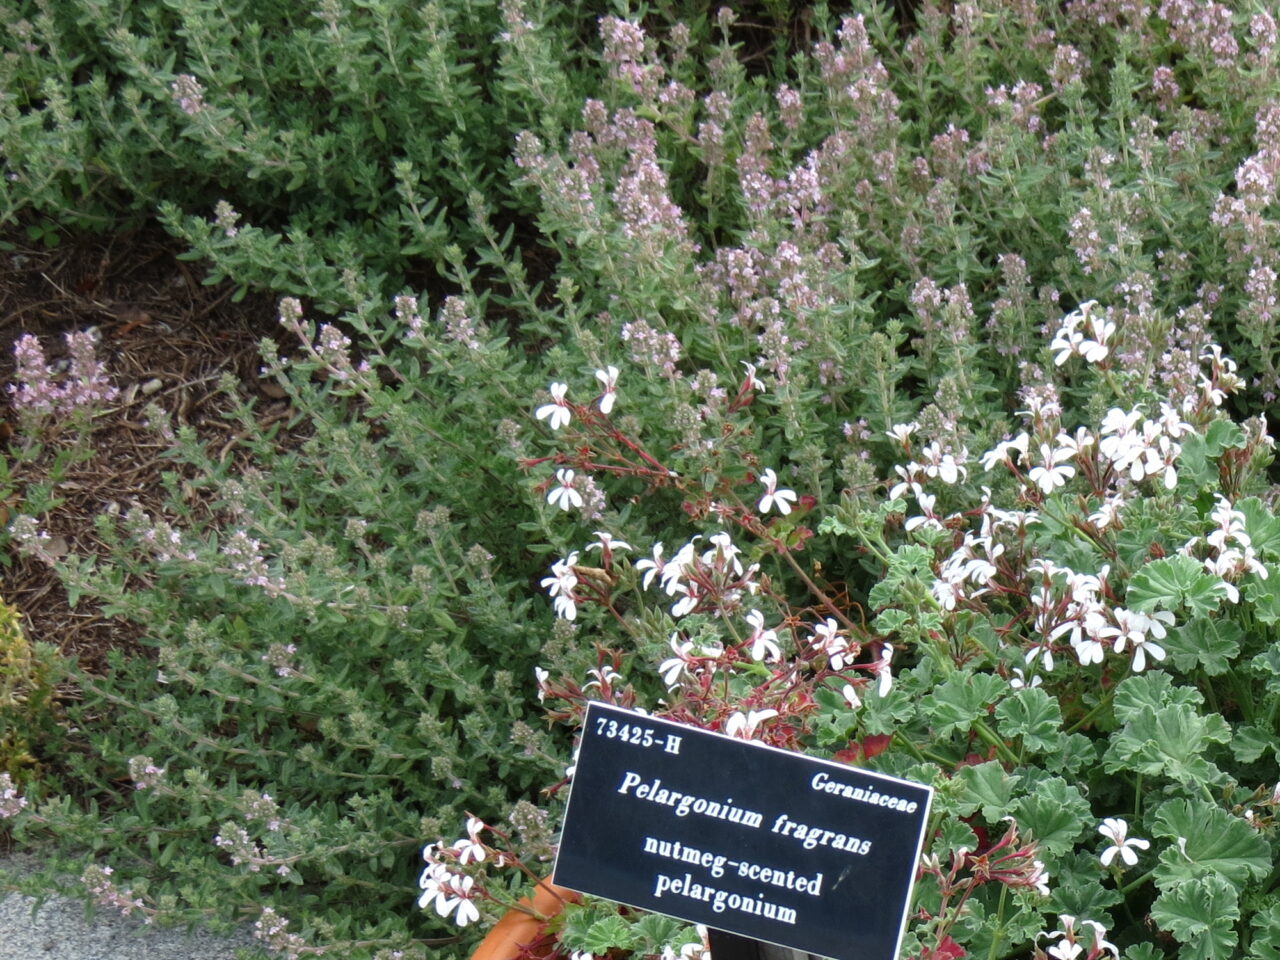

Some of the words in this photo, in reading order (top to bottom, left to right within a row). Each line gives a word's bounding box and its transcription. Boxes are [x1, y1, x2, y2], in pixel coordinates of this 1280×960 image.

[596, 717, 682, 755] 73425-H
[618, 771, 763, 828] Pelargonium
[771, 814, 872, 856] fragrans
[811, 772, 918, 814] Geraniaceae
[644, 835, 823, 896] nutmeg-scented
[654, 873, 797, 924] pelargonium
